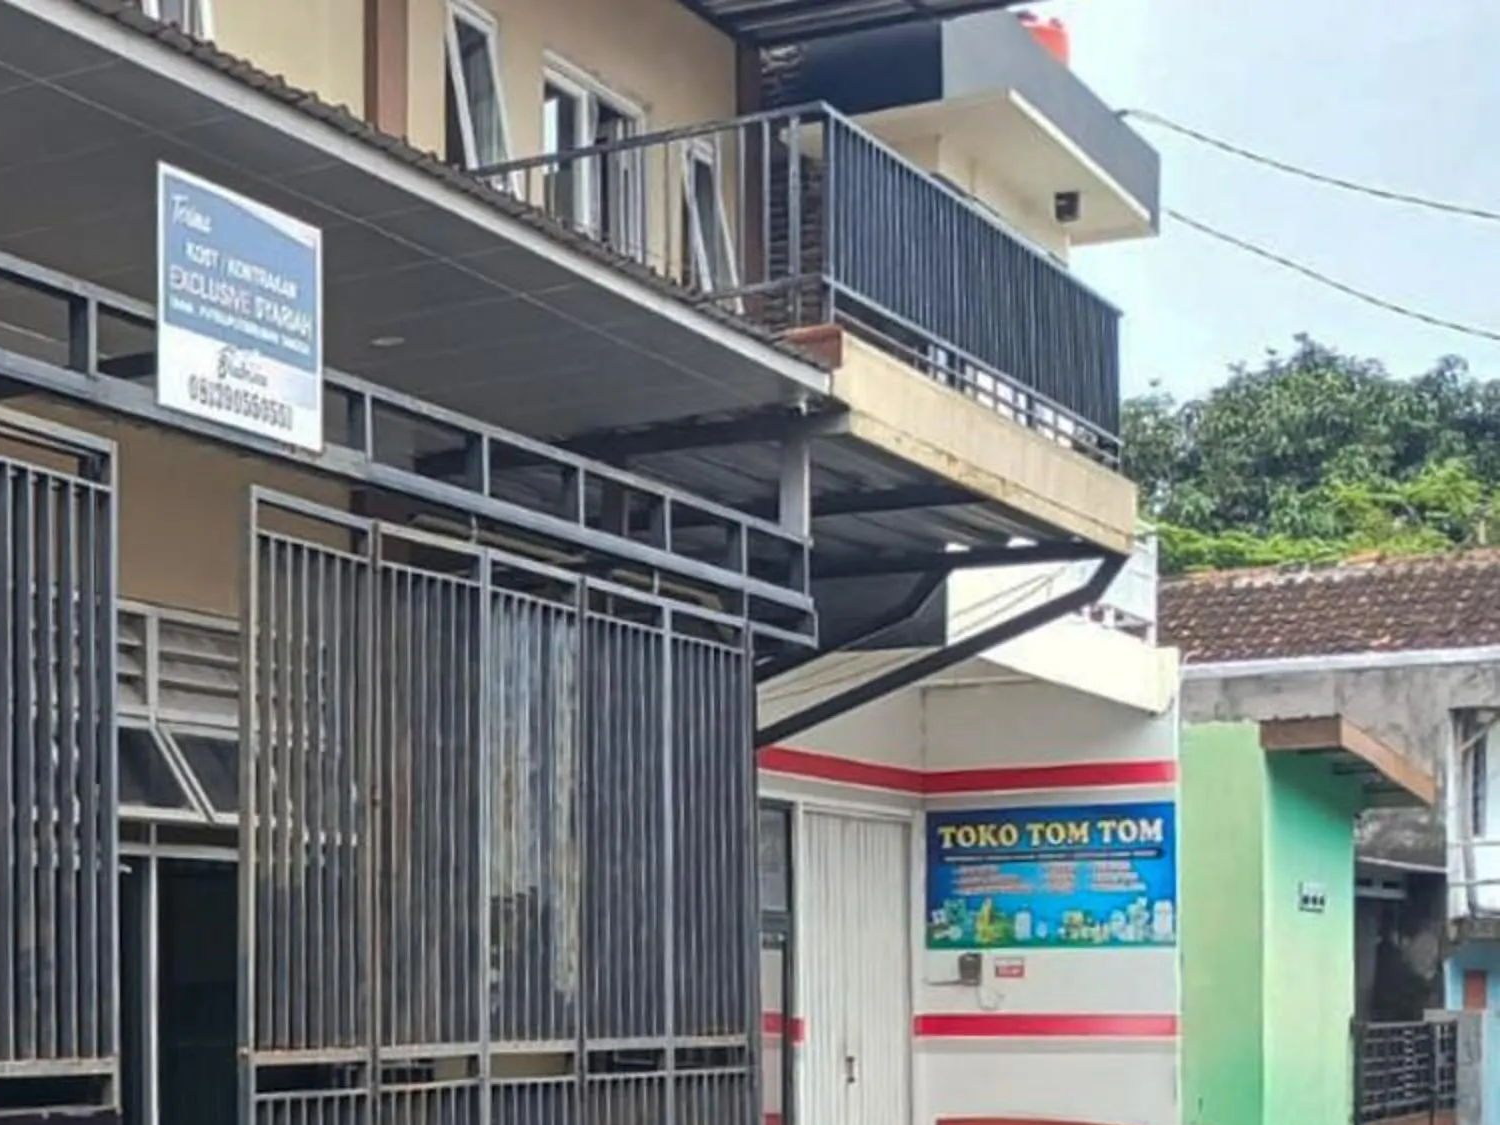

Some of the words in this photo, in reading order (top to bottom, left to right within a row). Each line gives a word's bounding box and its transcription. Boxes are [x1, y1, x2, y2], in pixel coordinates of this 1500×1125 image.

[937, 823, 1019, 849] TOKO
[1026, 820, 1090, 846] TOM
[1097, 817, 1164, 843] TOM
